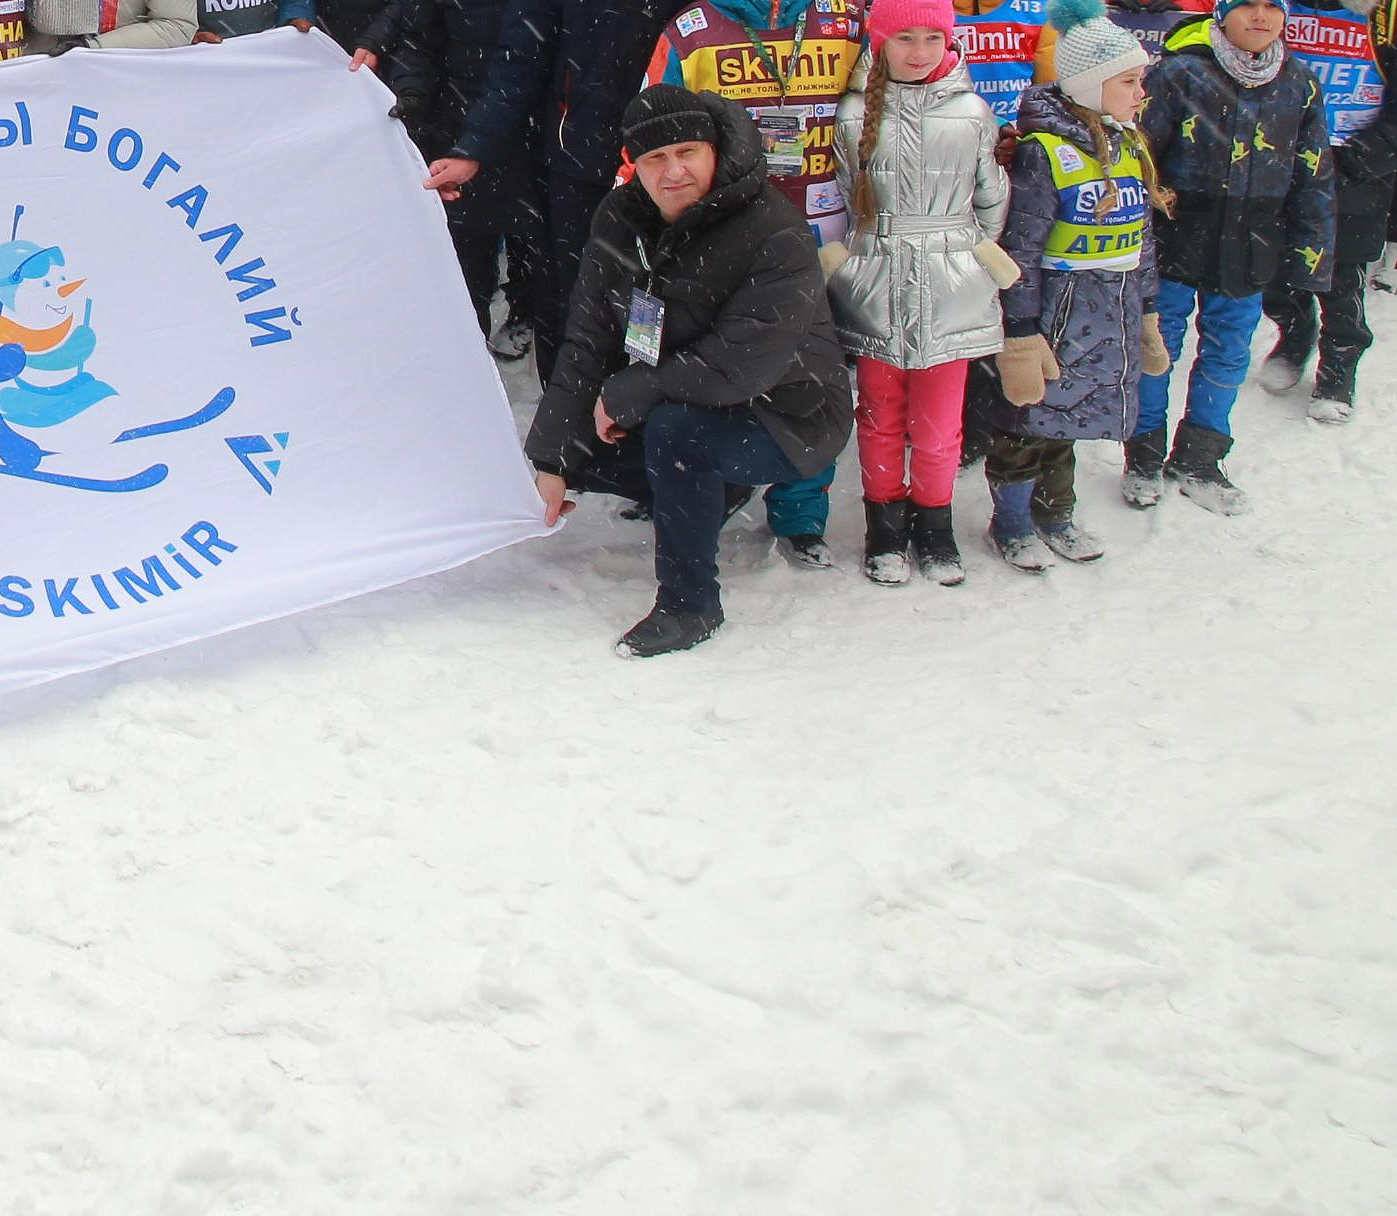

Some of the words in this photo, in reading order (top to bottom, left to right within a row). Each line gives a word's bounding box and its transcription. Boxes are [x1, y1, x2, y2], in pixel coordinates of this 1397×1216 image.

[1010, 0, 1042, 13] 413
[1286, 16, 1369, 50] skimir
[1306, 59, 1371, 86] ЛЕТ
[62, 104, 302, 349] БОГАЛИЙ
[1064, 230, 1142, 254] АТЛЕ
